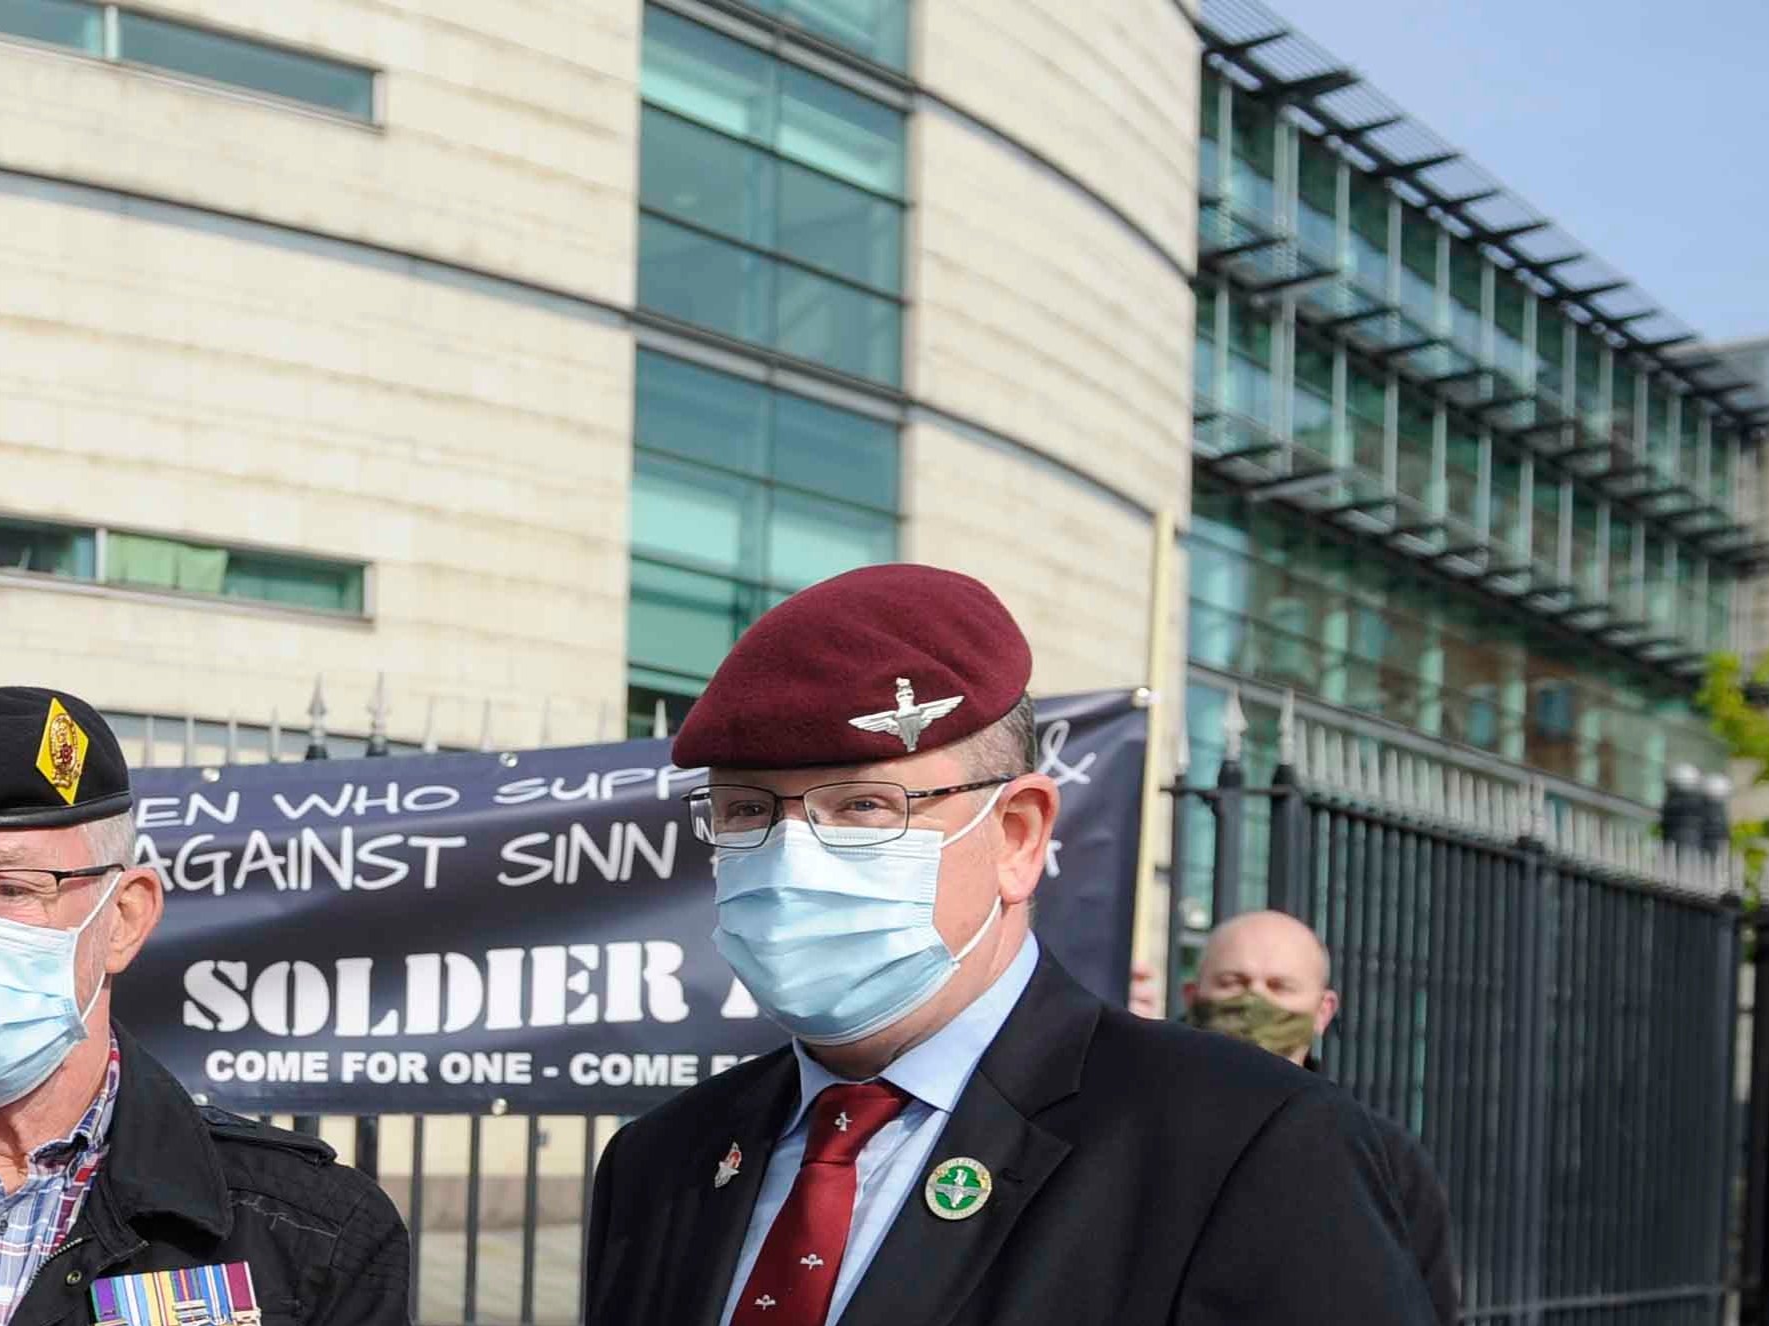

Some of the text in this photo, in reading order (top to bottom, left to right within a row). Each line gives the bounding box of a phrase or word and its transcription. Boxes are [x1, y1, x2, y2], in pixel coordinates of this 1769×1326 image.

[135, 791, 240, 829] EN
[273, 782, 461, 818] WHO
[493, 764, 710, 804] SUPP
[134, 825, 467, 896] AGAINST
[497, 820, 679, 887] SINN
[182, 939, 691, 1038] SOLDIER
[205, 1050, 330, 1084] COME
[342, 1052, 430, 1085] FOR
[439, 1052, 533, 1085] ONE
[569, 1053, 700, 1087] COME
